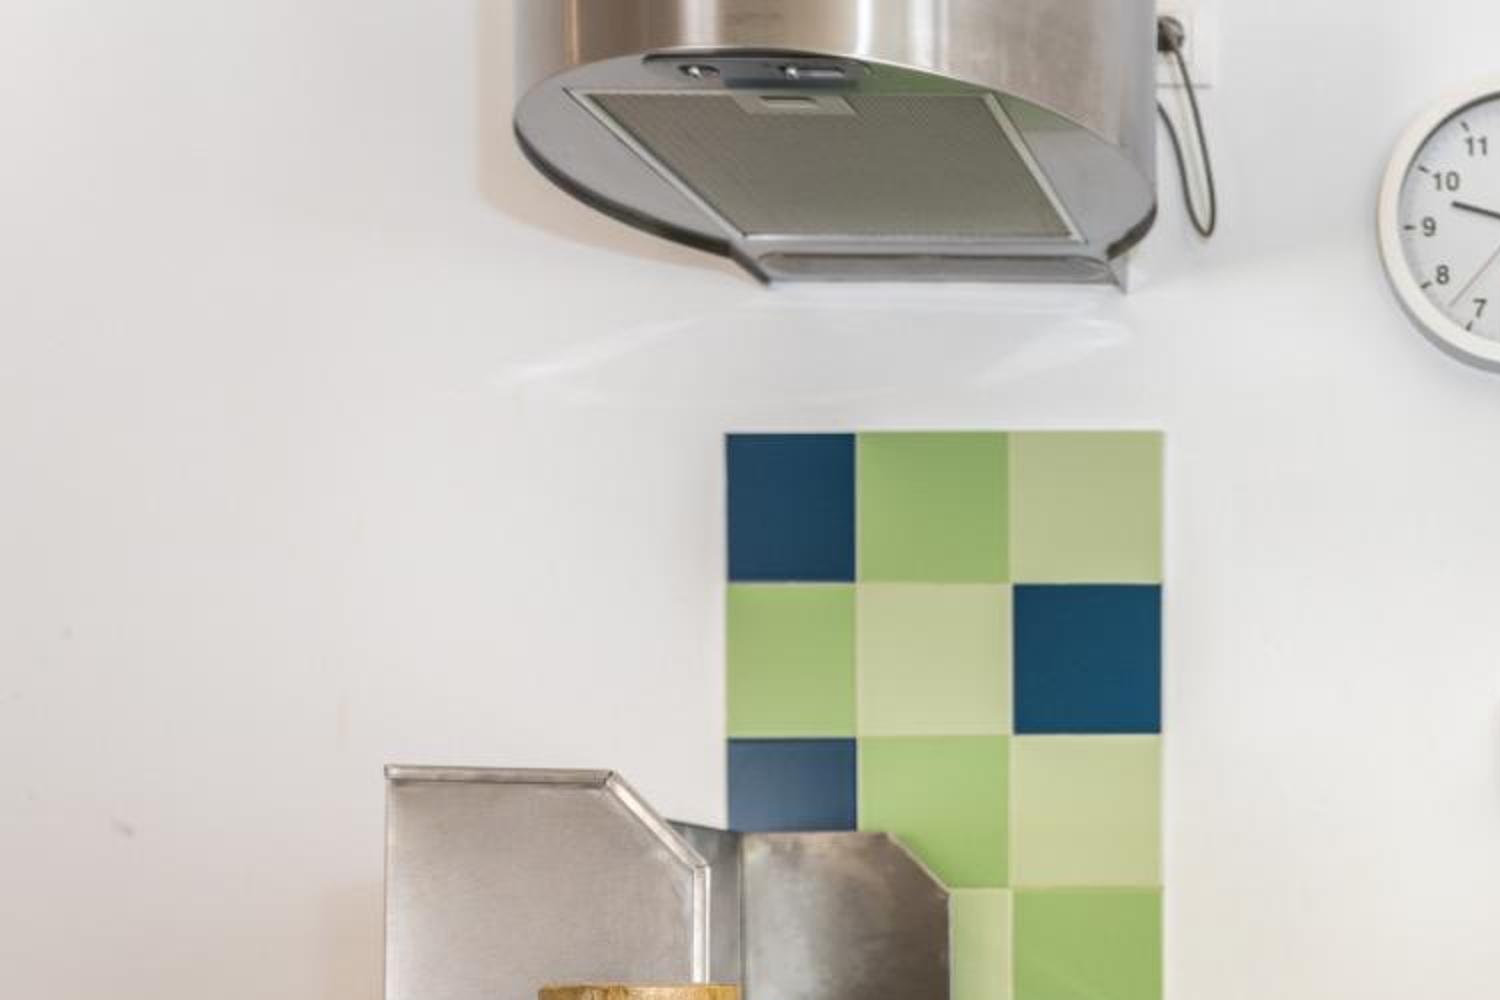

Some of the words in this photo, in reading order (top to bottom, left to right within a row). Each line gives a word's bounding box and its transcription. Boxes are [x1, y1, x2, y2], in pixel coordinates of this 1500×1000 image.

[1465, 136, 1488, 156] 11
[1433, 171, 1460, 191] 10
[1422, 217, 1437, 237] 9
[1436, 264, 1450, 285] 8
[1473, 298, 1488, 318] 7
